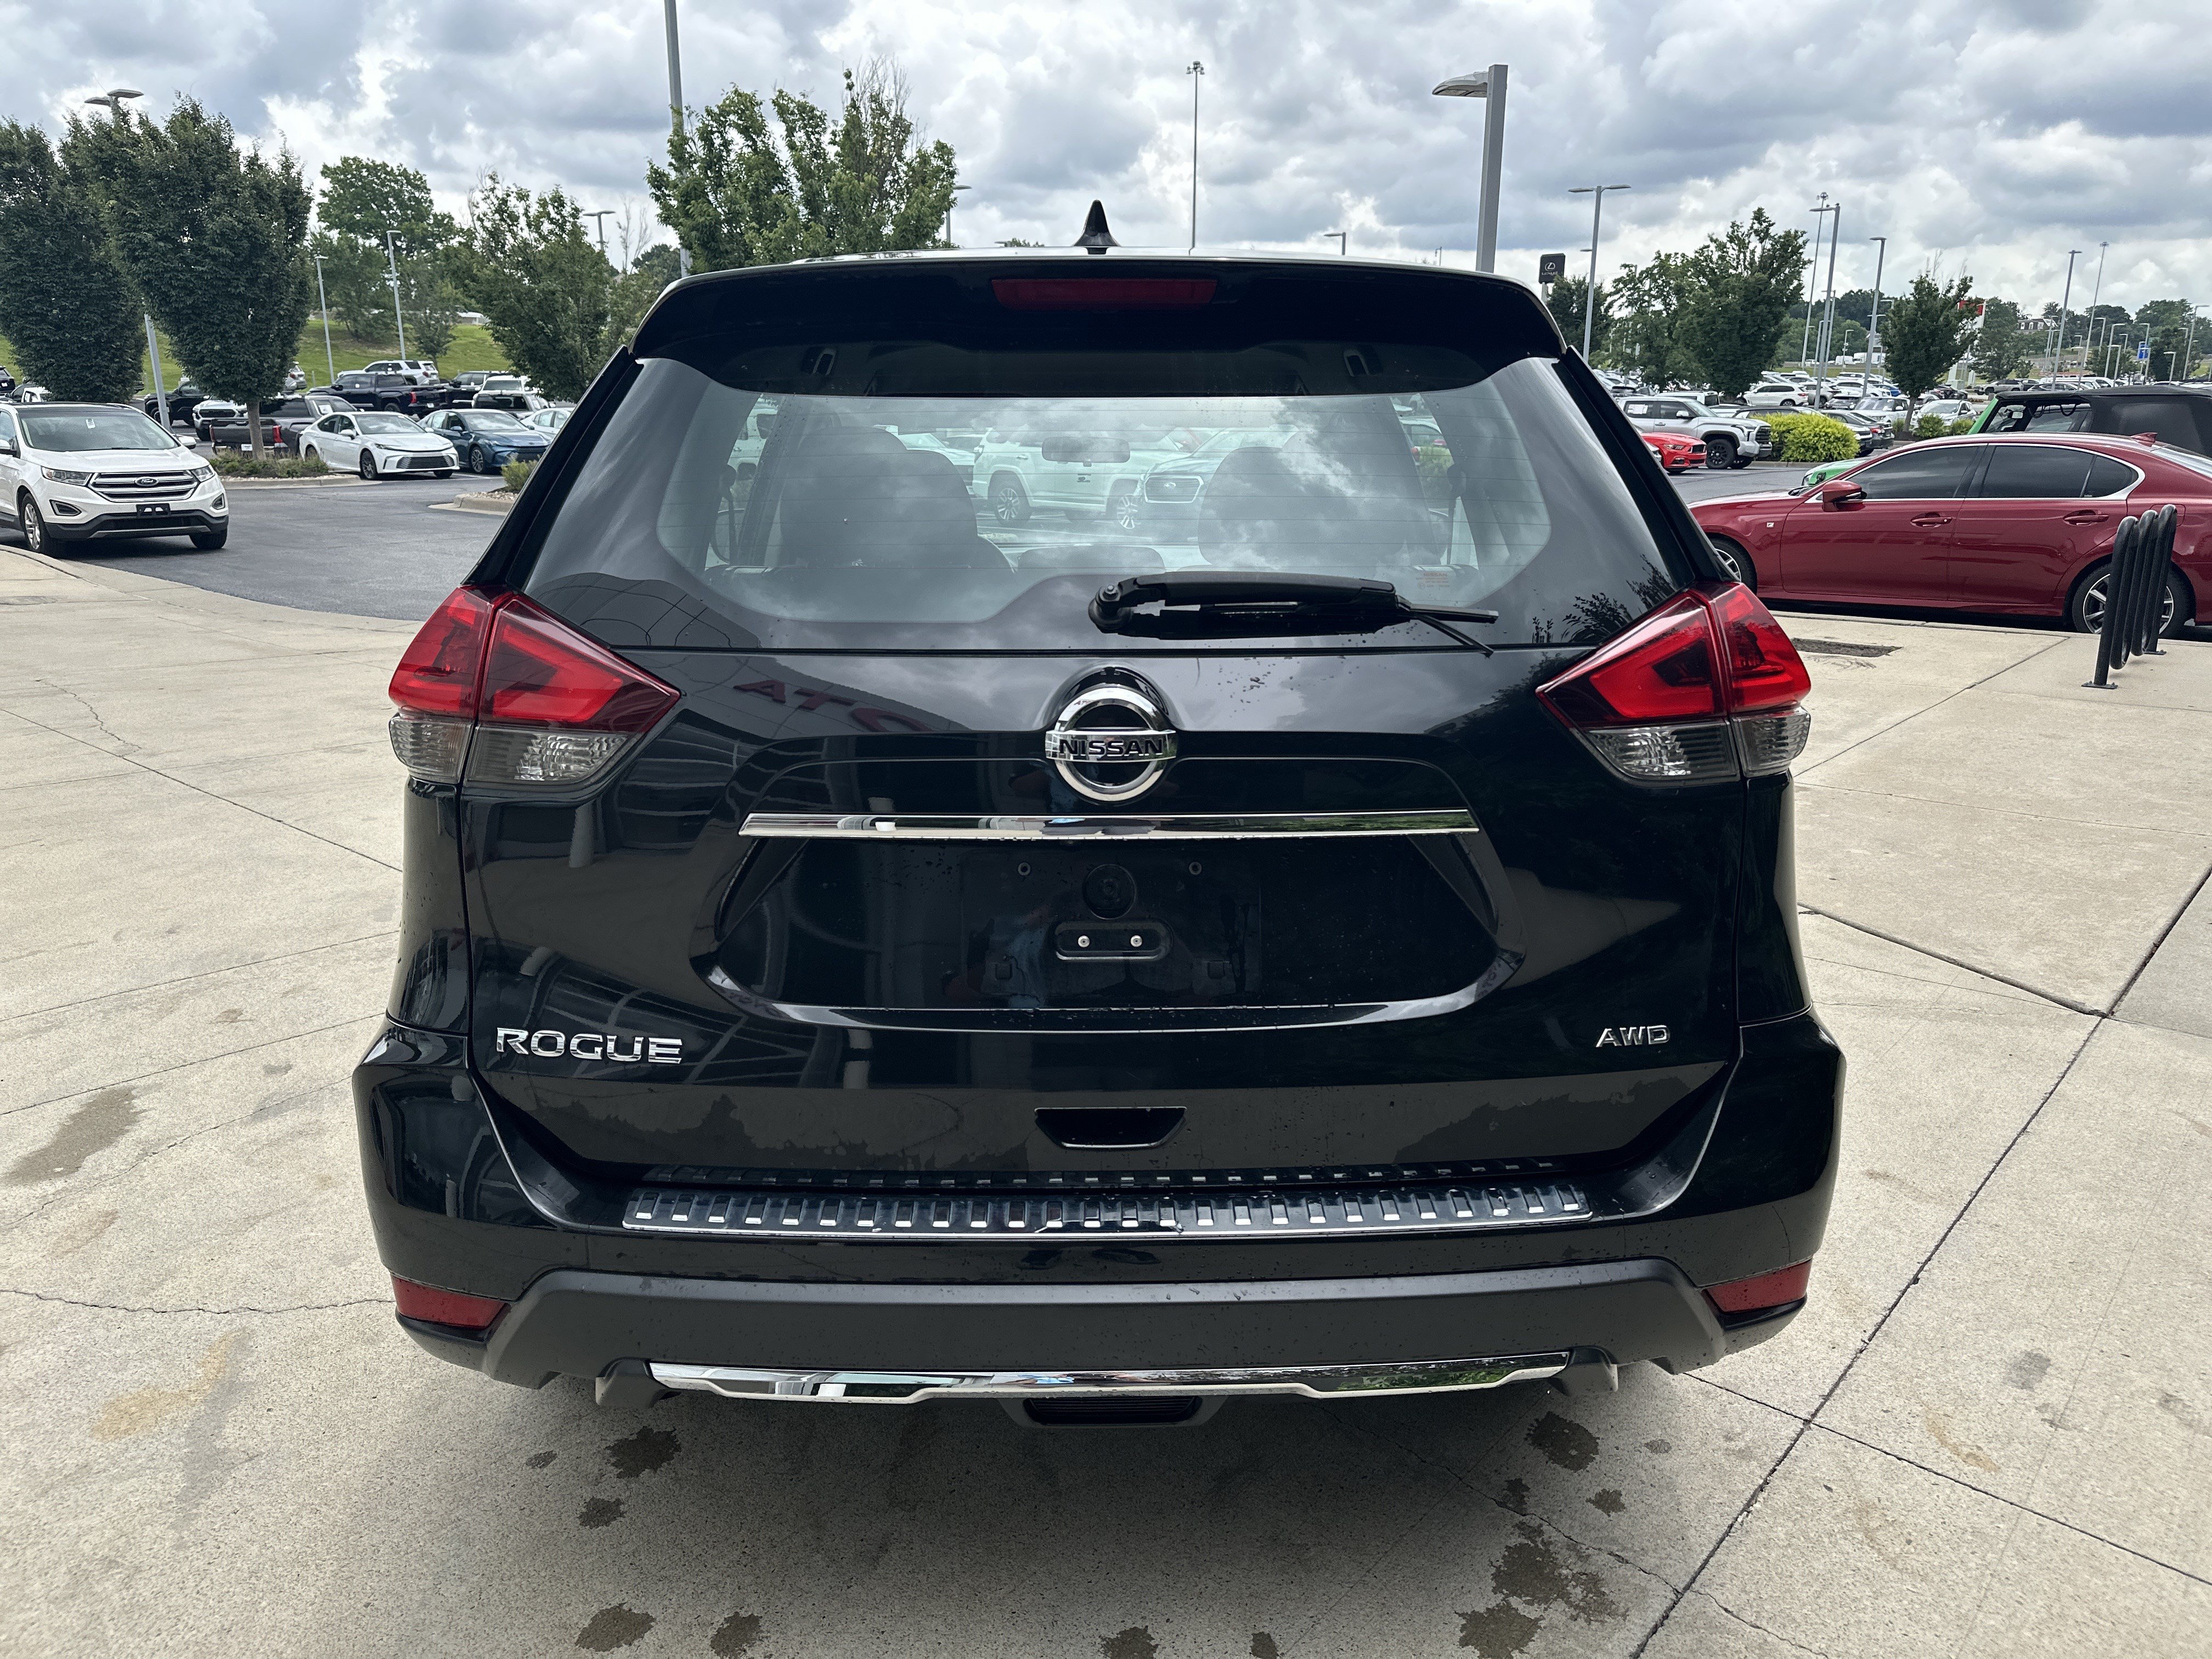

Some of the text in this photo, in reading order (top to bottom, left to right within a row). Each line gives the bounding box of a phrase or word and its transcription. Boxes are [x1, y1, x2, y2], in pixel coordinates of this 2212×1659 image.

[1059, 739, 1164, 757] NISSAN
[496, 1027, 682, 1064] ROGUE
[1595, 1025, 1671, 1048] AWD
